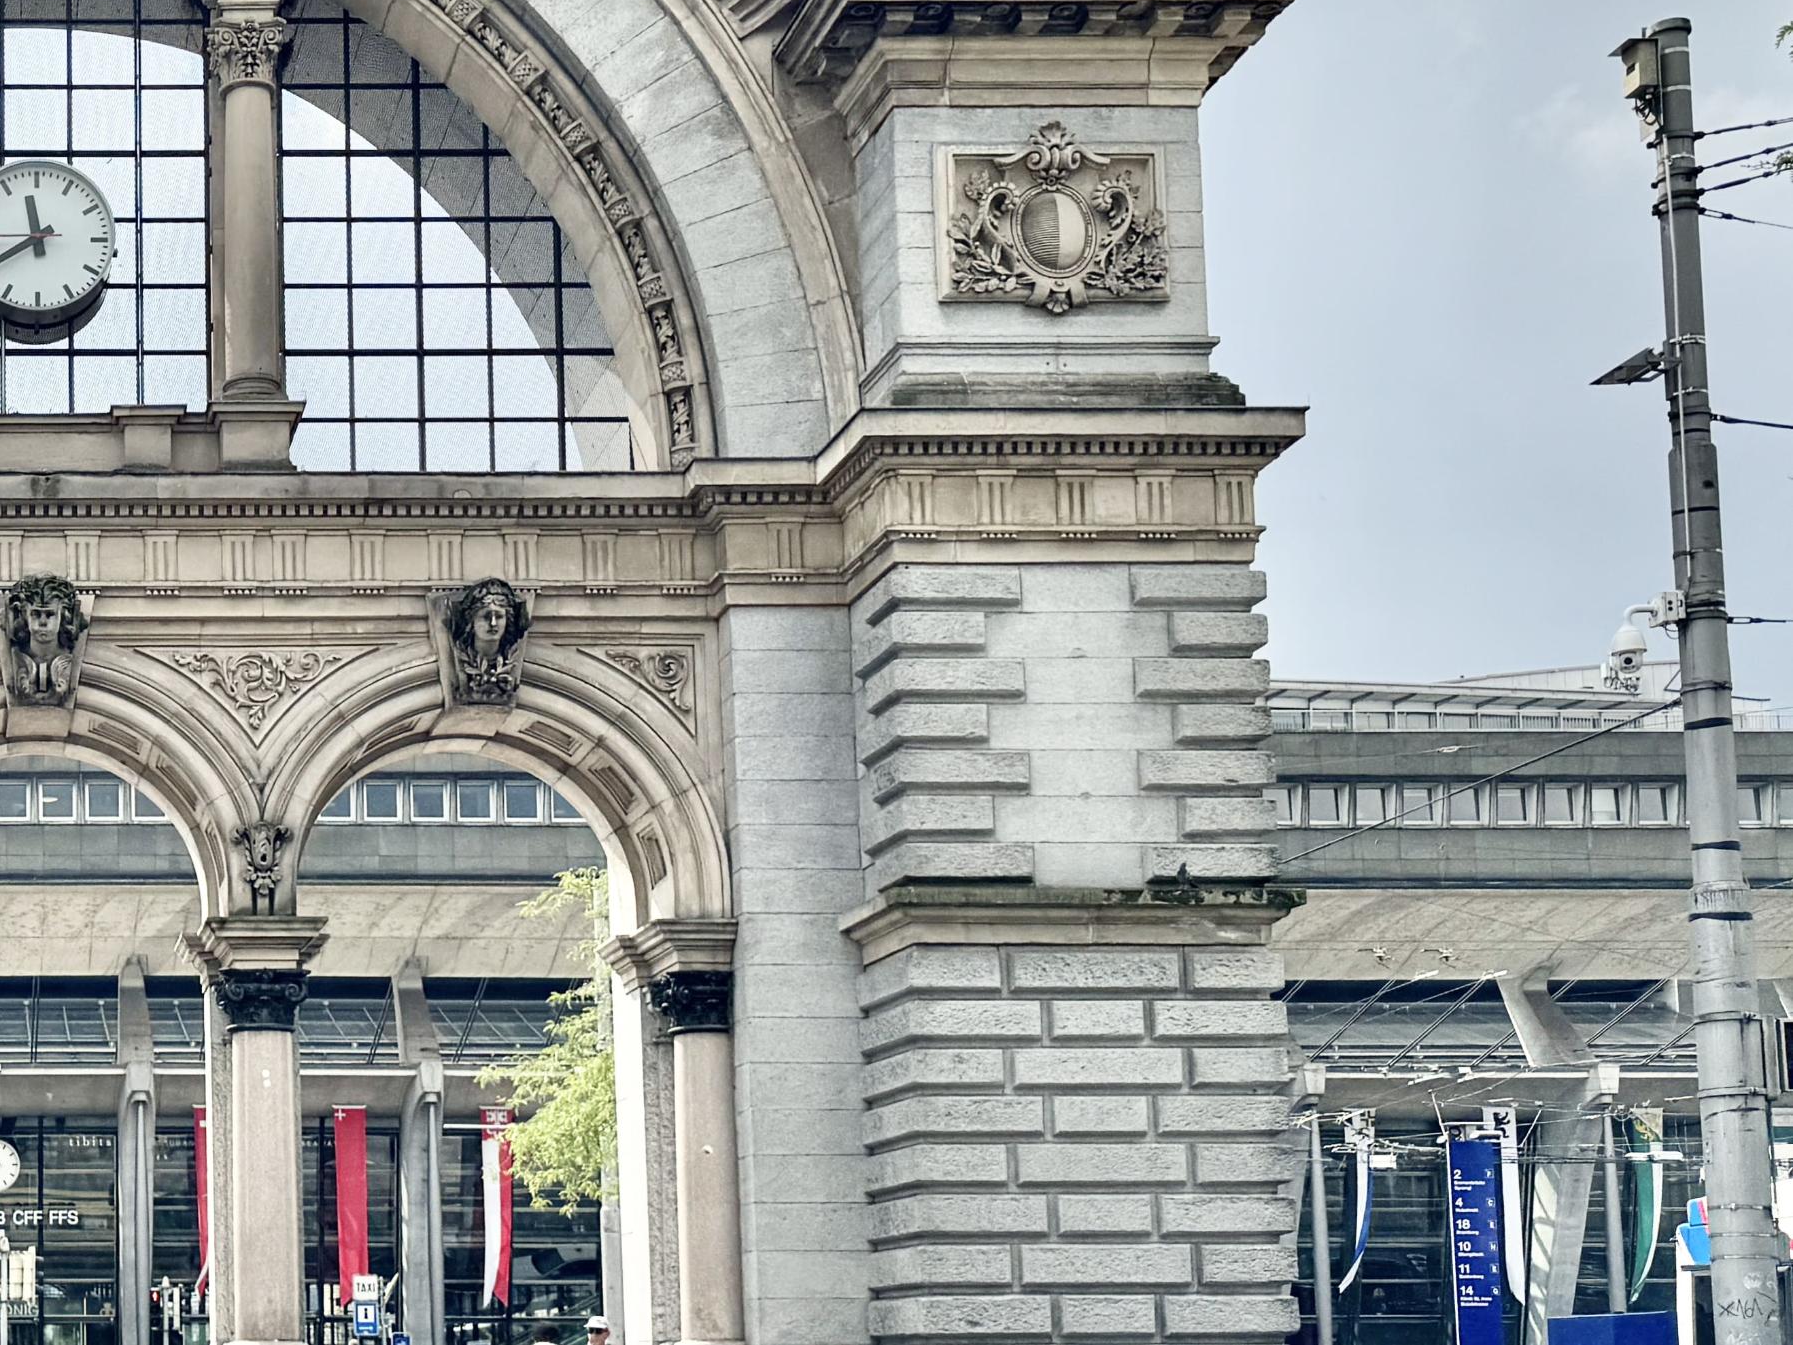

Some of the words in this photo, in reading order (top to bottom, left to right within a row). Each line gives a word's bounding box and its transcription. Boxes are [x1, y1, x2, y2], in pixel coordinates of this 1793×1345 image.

[1454, 1169, 1462, 1179] 2
[1455, 1197, 1463, 1207] 4
[12, 1209, 43, 1225] CFF
[49, 1209, 79, 1226] FFS
[1456, 1219, 1471, 1229] 18
[1457, 1241, 1471, 1252] 10
[1458, 1263, 1470, 1274] 11
[356, 1282, 376, 1293] TAXI
[1459, 1285, 1474, 1296] 14
